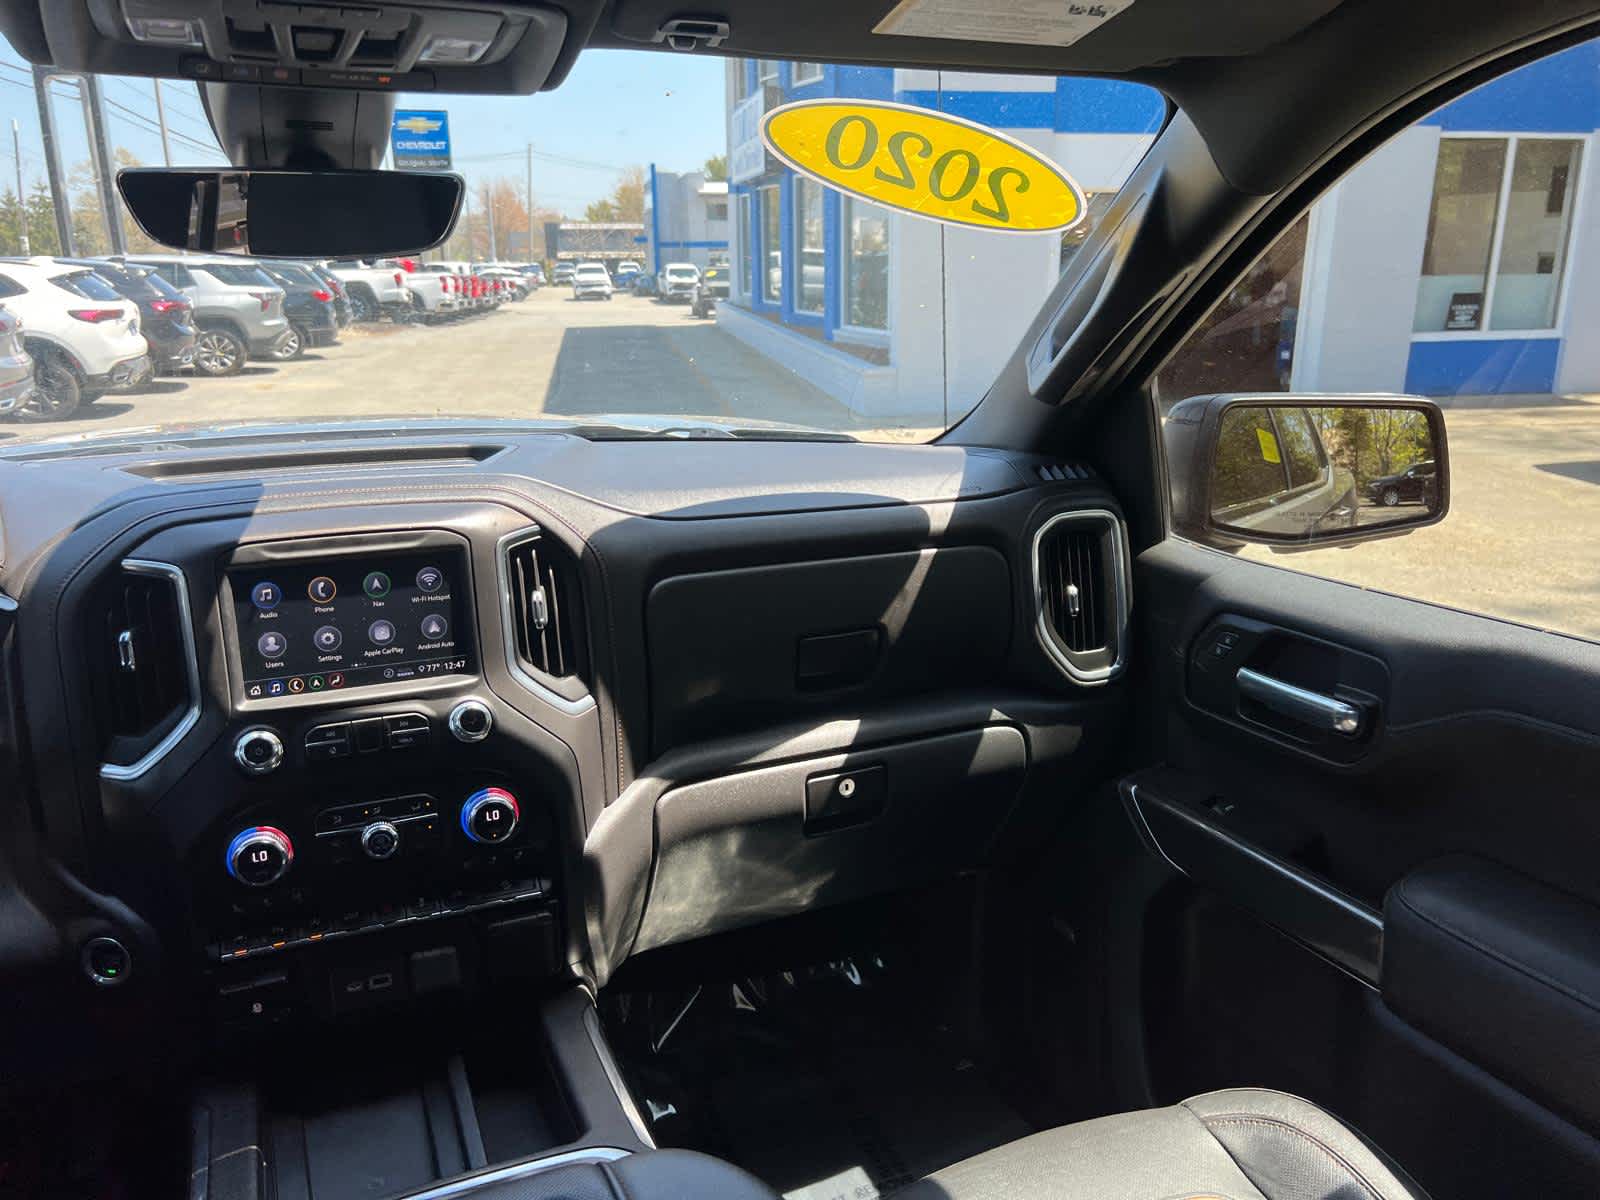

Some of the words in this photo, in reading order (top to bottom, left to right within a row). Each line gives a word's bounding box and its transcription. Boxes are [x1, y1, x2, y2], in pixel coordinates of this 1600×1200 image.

[396, 141, 447, 150] CHEVROLET
[428, 593, 451, 602] Hotspot
[314, 605, 335, 613] Phone
[259, 611, 279, 619] Audio
[418, 642, 440, 650] Android
[441, 640, 455, 648] Auto
[364, 649, 382, 657] Apple
[318, 654, 342, 663] Settings
[444, 660, 465, 670] 12:47
